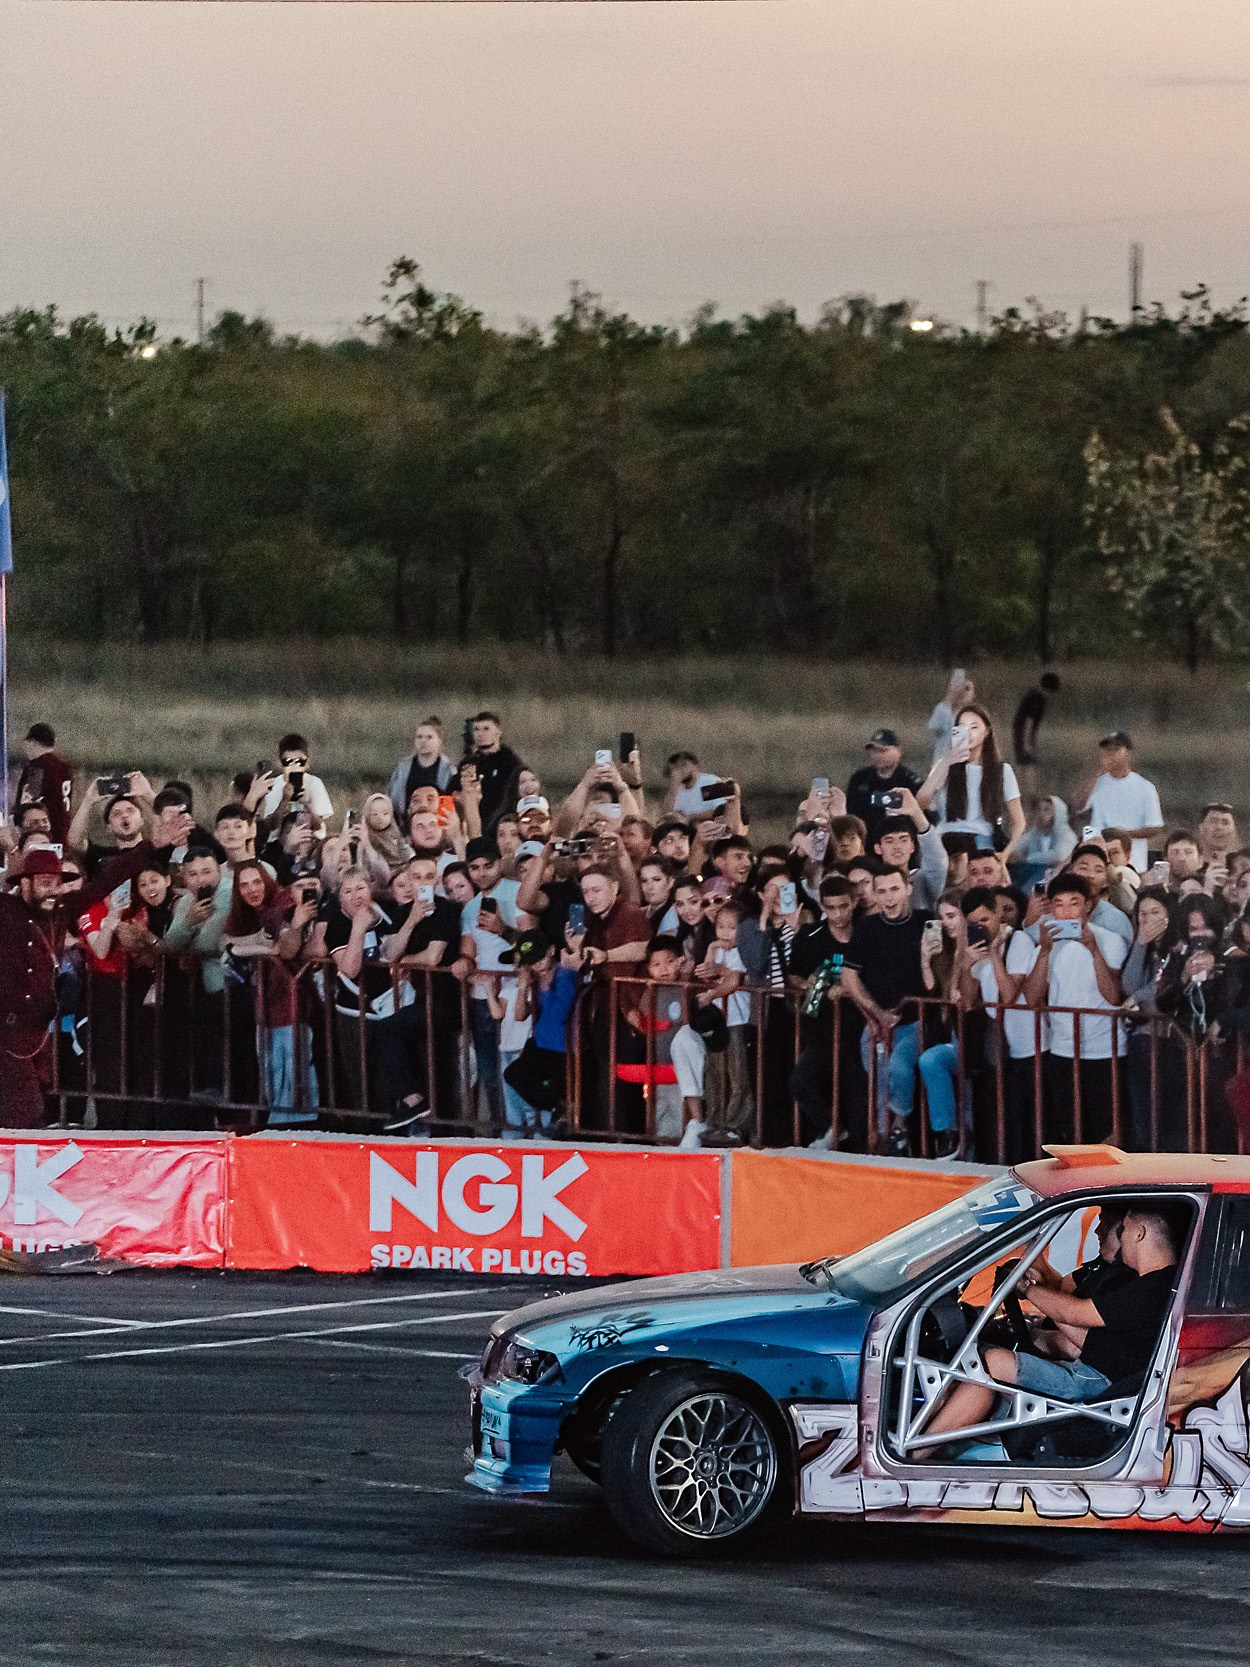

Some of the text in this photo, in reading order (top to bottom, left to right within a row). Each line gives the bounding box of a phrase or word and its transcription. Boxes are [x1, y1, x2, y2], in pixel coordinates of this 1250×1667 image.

[0, 1142, 85, 1228] K
[369, 1150, 589, 1243] NGK
[370, 1244, 588, 1276] SPARK PLUGS
